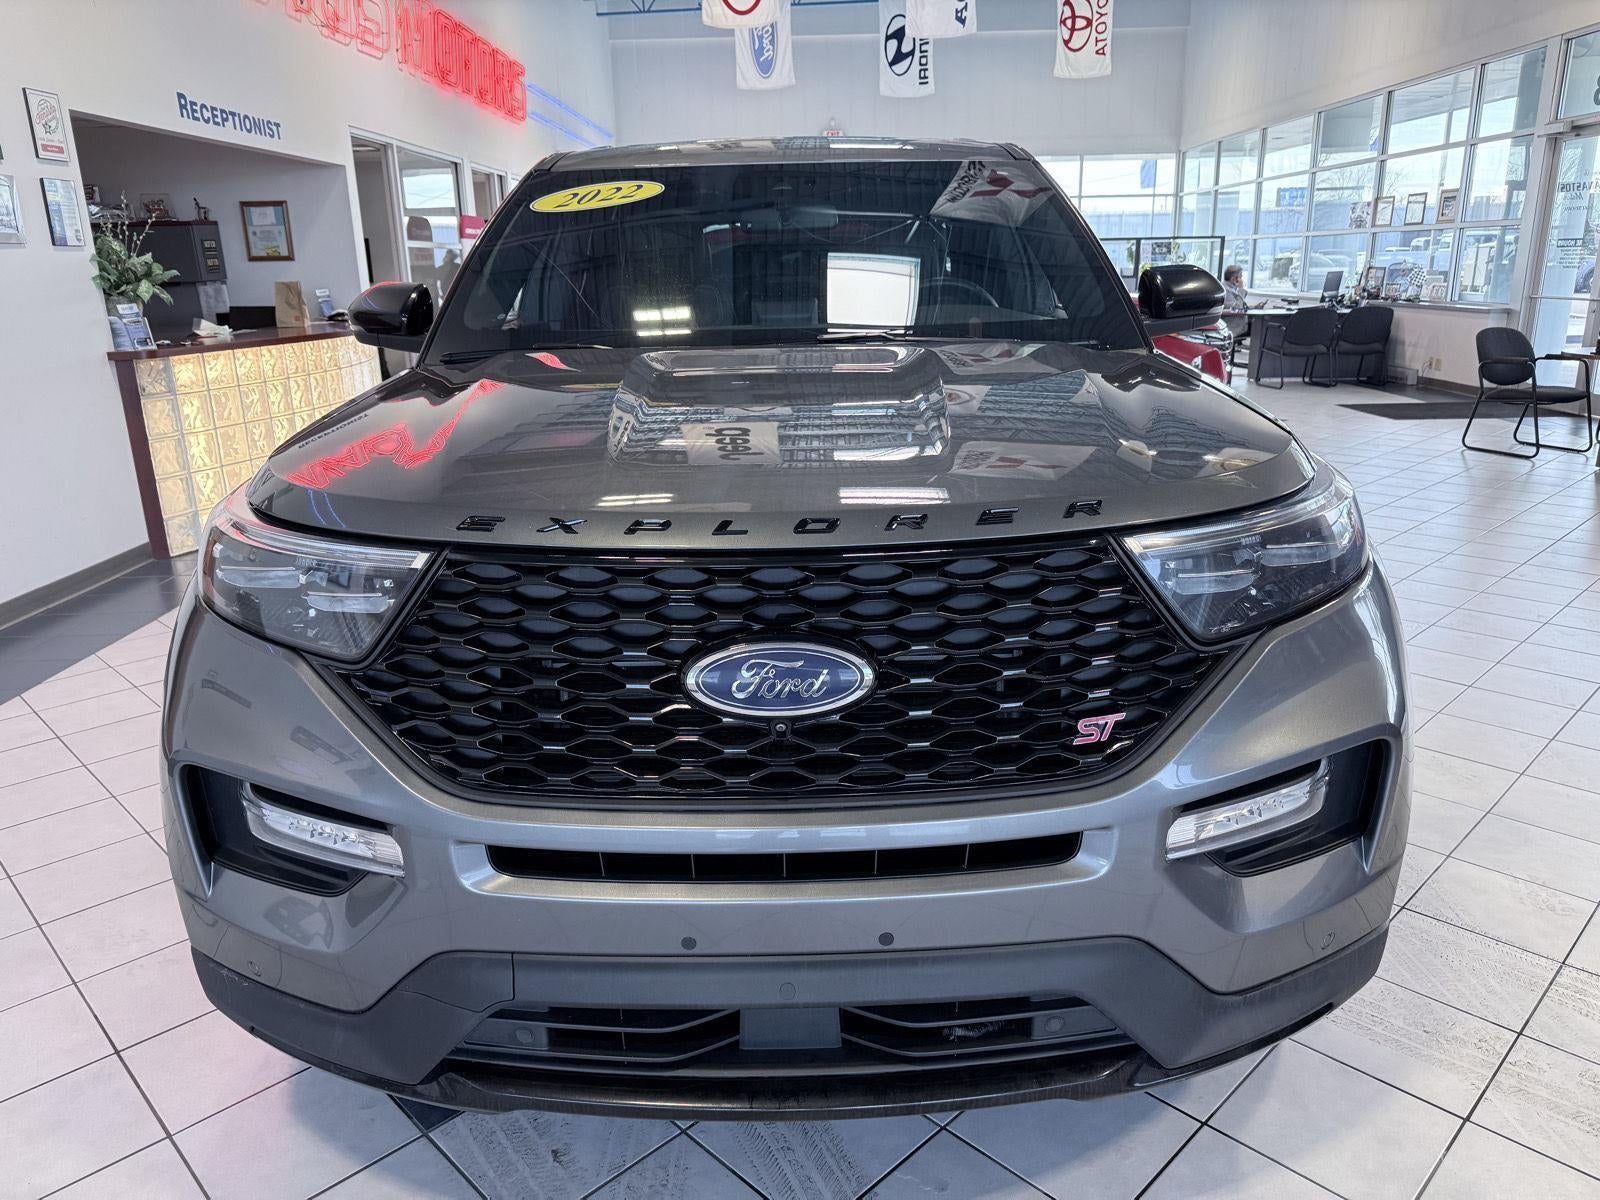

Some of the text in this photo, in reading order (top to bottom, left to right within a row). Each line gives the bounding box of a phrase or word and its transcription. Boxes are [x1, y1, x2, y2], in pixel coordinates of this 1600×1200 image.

[396, 0, 526, 122] MOTORS
[176, 91, 281, 140] RECEPTIONIST
[552, 184, 644, 209] 2022
[455, 499, 1104, 535] EXPLORER
[731, 659, 829, 699] Ford
[1073, 712, 1126, 745] ST
